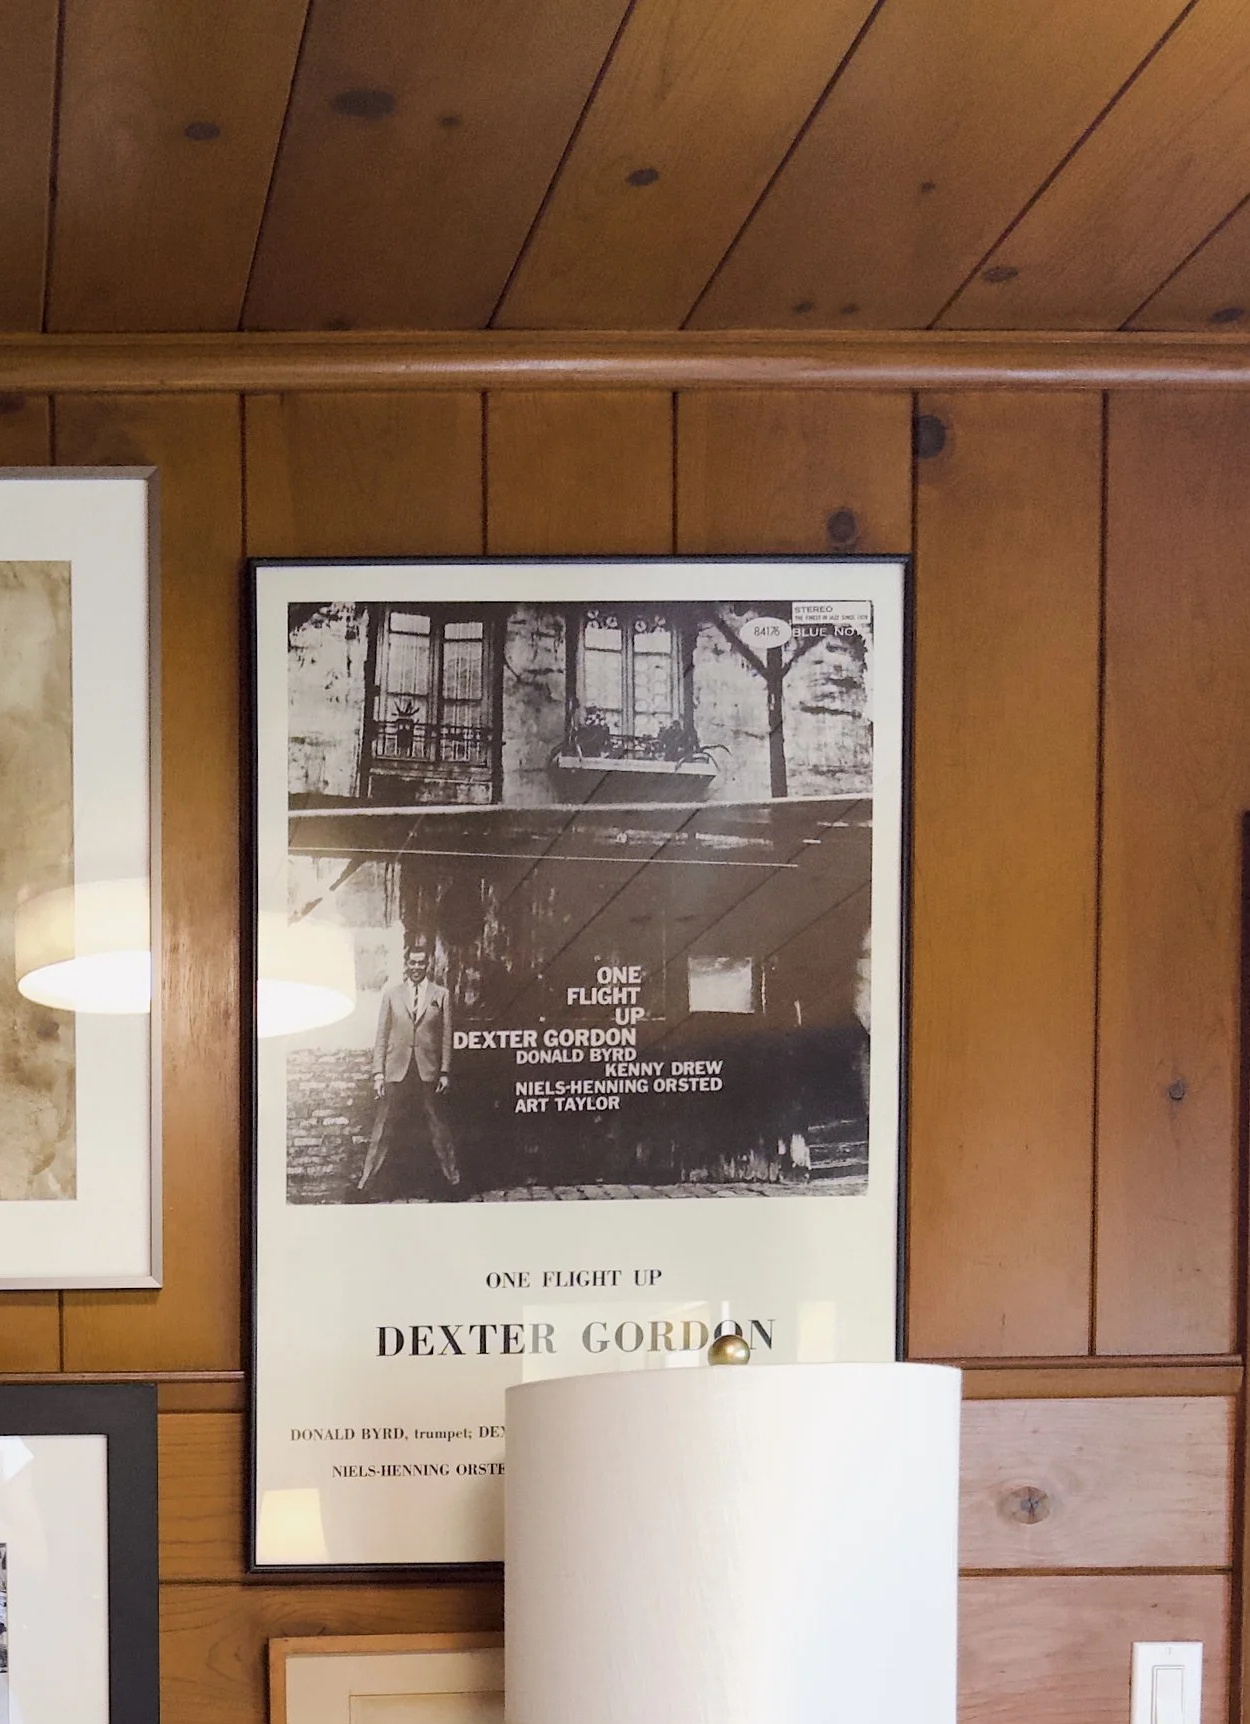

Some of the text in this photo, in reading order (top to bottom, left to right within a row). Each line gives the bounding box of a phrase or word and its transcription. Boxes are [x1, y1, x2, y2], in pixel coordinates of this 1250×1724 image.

[794, 605, 833, 613] STEREO
[754, 626, 780, 637] 84176
[792, 627, 828, 638] BLUE
[597, 966, 642, 984] ONE
[567, 987, 641, 1006] FLIGHT
[615, 1008, 645, 1026] UP
[453, 1028, 637, 1050] DEXTER GORDON
[516, 1048, 637, 1065] DONALD BYRD
[605, 1061, 723, 1077] KENNY DREW
[515, 1078, 722, 1096] NIELS-HENNING ORSTED
[515, 1096, 620, 1113] ART TAYLOR
[486, 1269, 662, 1289] ONE FLIGHT UP
[376, 1322, 557, 1357] DEXTER
[291, 1427, 355, 1441] DONALD
[361, 1427, 409, 1441] BYRD,
[414, 1429, 473, 1442] trumpet;
[332, 1464, 450, 1478] NIELS-HENNING
